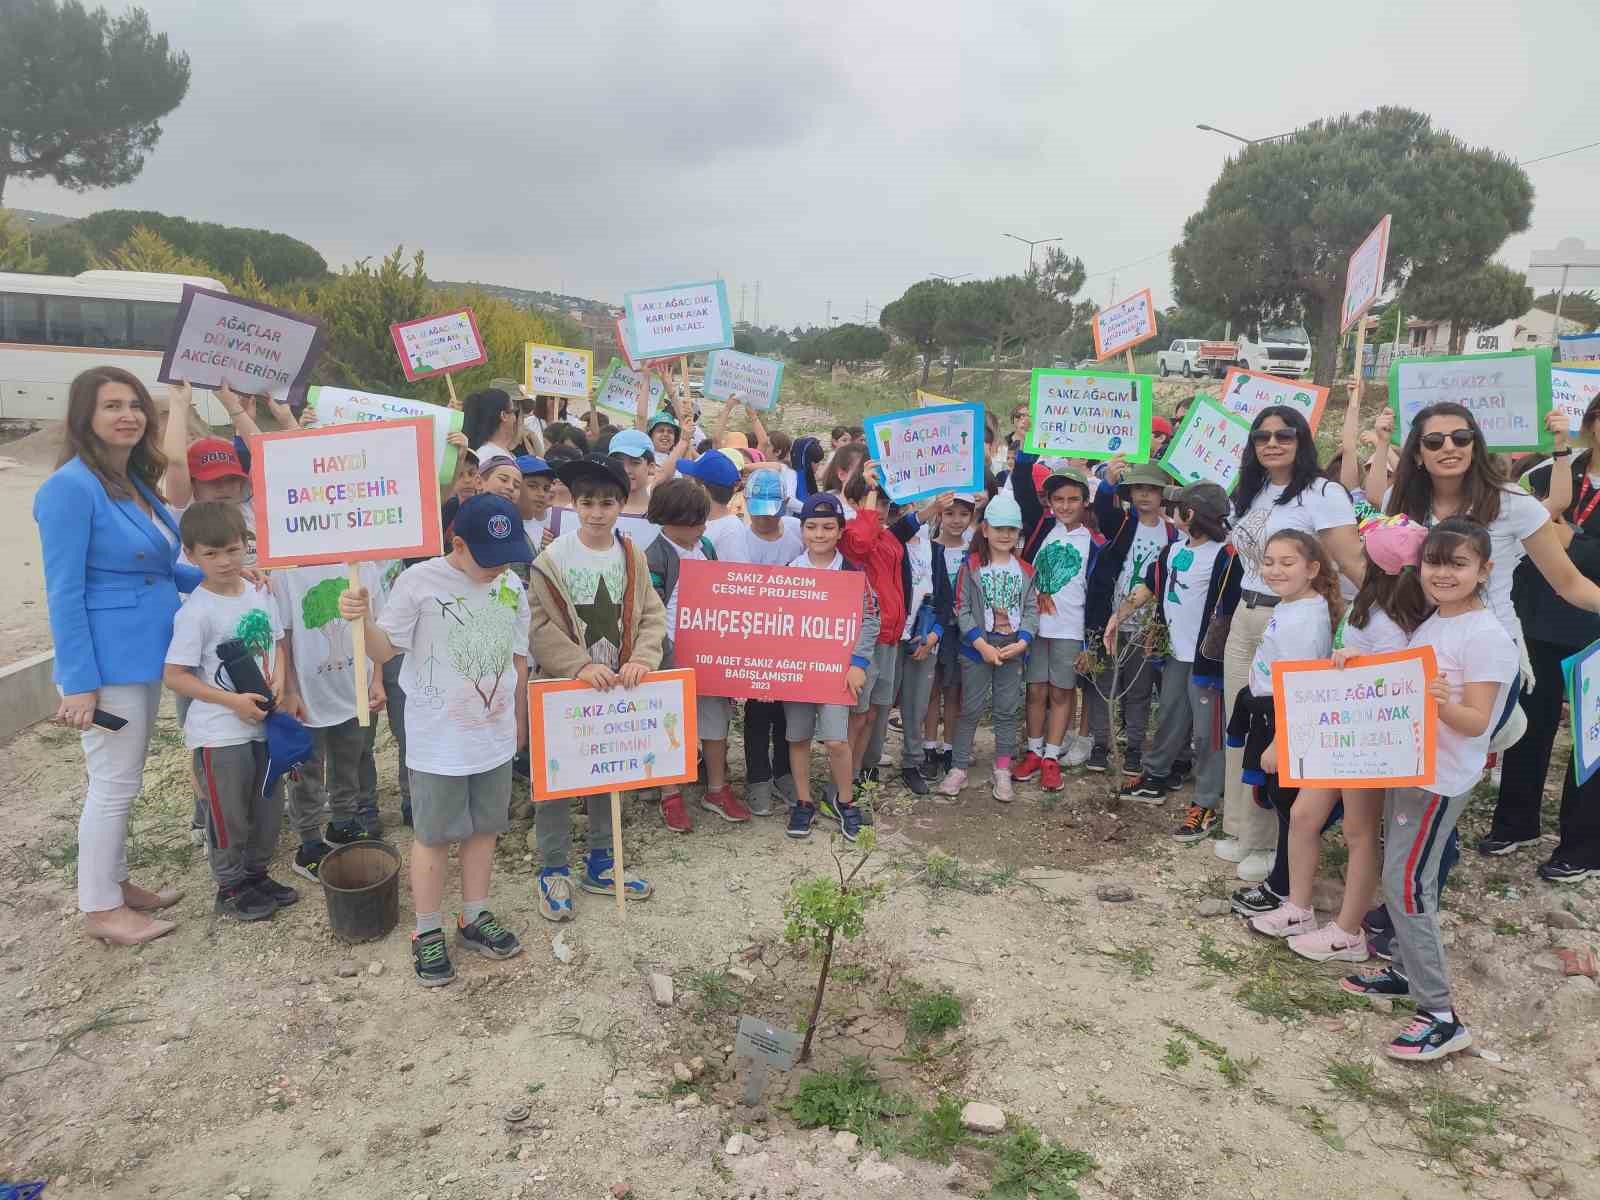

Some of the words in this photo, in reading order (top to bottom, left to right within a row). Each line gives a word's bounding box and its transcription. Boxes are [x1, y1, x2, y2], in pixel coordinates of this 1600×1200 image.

[216, 316, 282, 342] AĞAÇLAR
[1044, 404, 1070, 416] ANA
[1073, 405, 1131, 420] VATANINA
[313, 448, 368, 474] HAYDİ
[287, 475, 398, 505] BAHÇEŞEHİR
[286, 512, 342, 533] UMUT
[346, 507, 403, 529] SİZDE!
[727, 571, 764, 584] SAKIZ
[679, 606, 796, 640] BAHÇEŞEHİR
[799, 611, 858, 648] KOLEJİ
[695, 653, 713, 666] 100
[715, 654, 742, 667] ADET
[743, 656, 774, 670] SAKIZ
[751, 681, 771, 690] 2023
[563, 703, 605, 720] SAKIZ
[1377, 704, 1411, 721] AYAK
